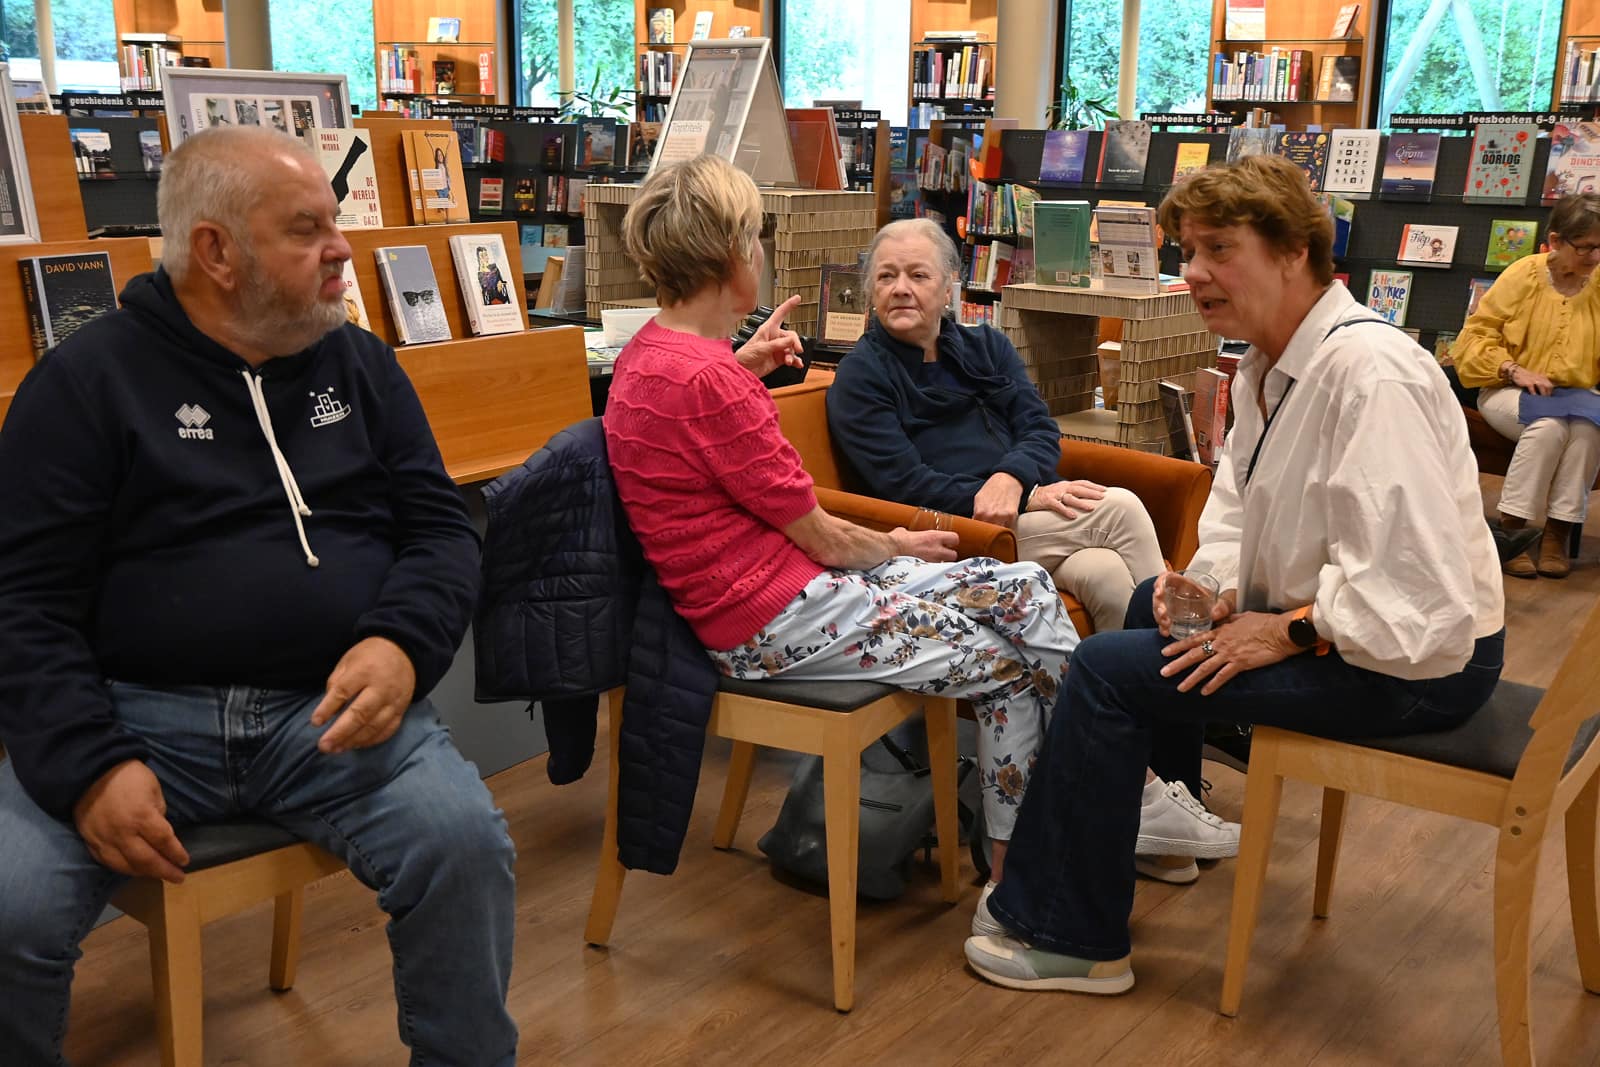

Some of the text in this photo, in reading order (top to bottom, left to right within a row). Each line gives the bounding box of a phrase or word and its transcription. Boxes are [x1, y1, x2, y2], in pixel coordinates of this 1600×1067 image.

[70, 96, 124, 106] geschiedenis
[494, 107, 509, 115] jaar
[841, 111, 863, 119] 12-15
[863, 112, 880, 120] jaar
[1144, 114, 1233, 126] leesboeken 6-9 jaar
[1391, 115, 1464, 125] informatieboeken 9
[1468, 114, 1583, 124] leesboeken 6-9 jaar
[1481, 153, 1521, 165] OORLOG
[366, 177, 374, 187] DE
[352, 190, 376, 201] WERELD
[369, 202, 378, 213] NA
[45, 260, 104, 274] DAVID VANN
